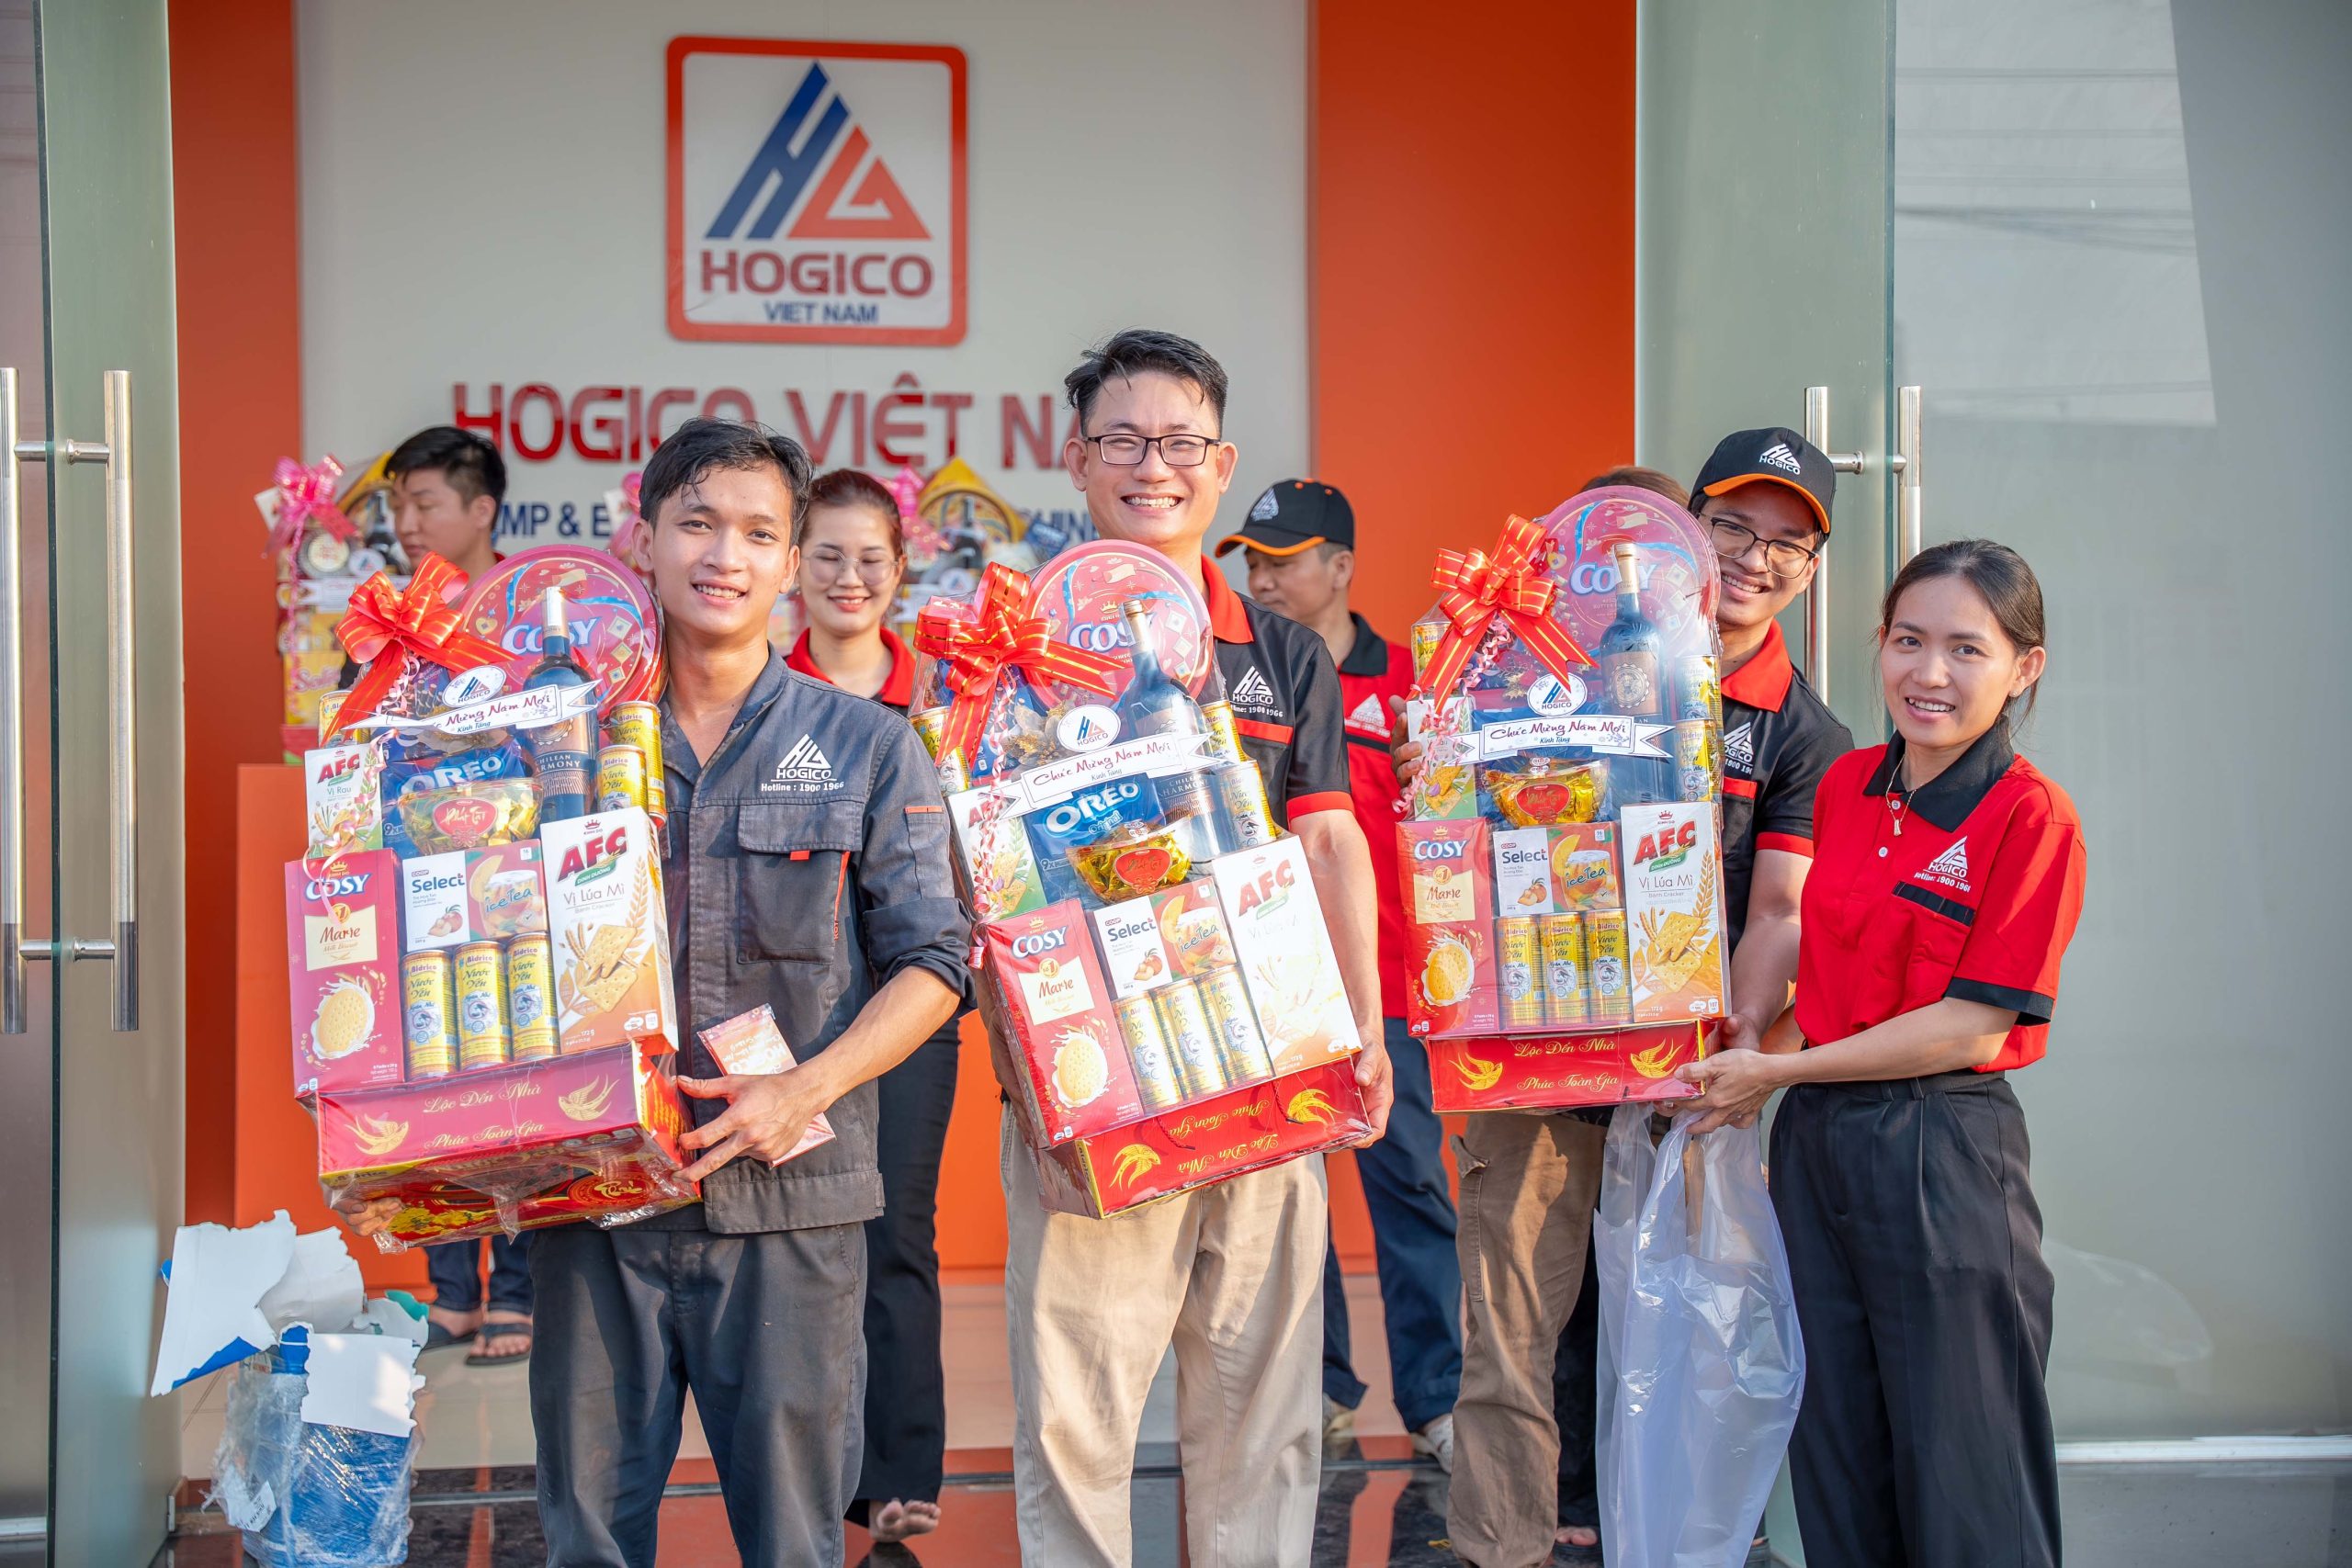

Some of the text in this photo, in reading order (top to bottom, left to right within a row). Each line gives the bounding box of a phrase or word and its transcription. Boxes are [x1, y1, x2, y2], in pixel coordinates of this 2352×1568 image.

[700, 249, 933, 299] HOGICO
[763, 301, 878, 324] VIET NAM
[1758, 455, 1802, 475] HOGICO
[1570, 562, 1658, 595] COY
[502, 616, 601, 655] COY
[1069, 617, 1144, 653] COS
[458, 689, 491, 704] HOGICO
[1232, 694, 1274, 705] HOGICO
[1541, 703, 1572, 711] HOGICO
[1077, 732, 1109, 747] HOGICO
[534, 754, 571, 767] HILEAN
[1724, 745, 1753, 762] OGICO
[317, 753, 361, 784] AFC
[400, 756, 502, 795] OREO
[535, 760, 582, 773] ARMONY
[775, 768, 832, 780] HOGICO
[761, 783, 791, 792] Hotline
[799, 783, 820, 792] 1900
[823, 782, 844, 791] 1966
[1046, 782, 1140, 834] OREO
[1413, 840, 1468, 861] COSY
[1633, 819, 1697, 866] AFC
[557, 826, 628, 883] AFC
[1502, 849, 1548, 864] Select
[1928, 862, 1967, 878] HOGICO
[305, 874, 371, 901] COSY
[412, 873, 465, 894] Select
[1238, 859, 1296, 918] AFC
[1654, 875, 1674, 889] Lúa
[1936, 875, 1955, 886] 1900
[581, 888, 603, 902] Lúa
[1426, 886, 1462, 902] Marie
[320, 926, 361, 944] Marie
[1107, 917, 1157, 942] Select
[1012, 926, 1068, 958] COSY
[467, 955, 493, 964] Bidrico
[513, 947, 538, 956] Bidrico
[411, 964, 437, 973] Bidrico
[1038, 979, 1074, 998] Marie
